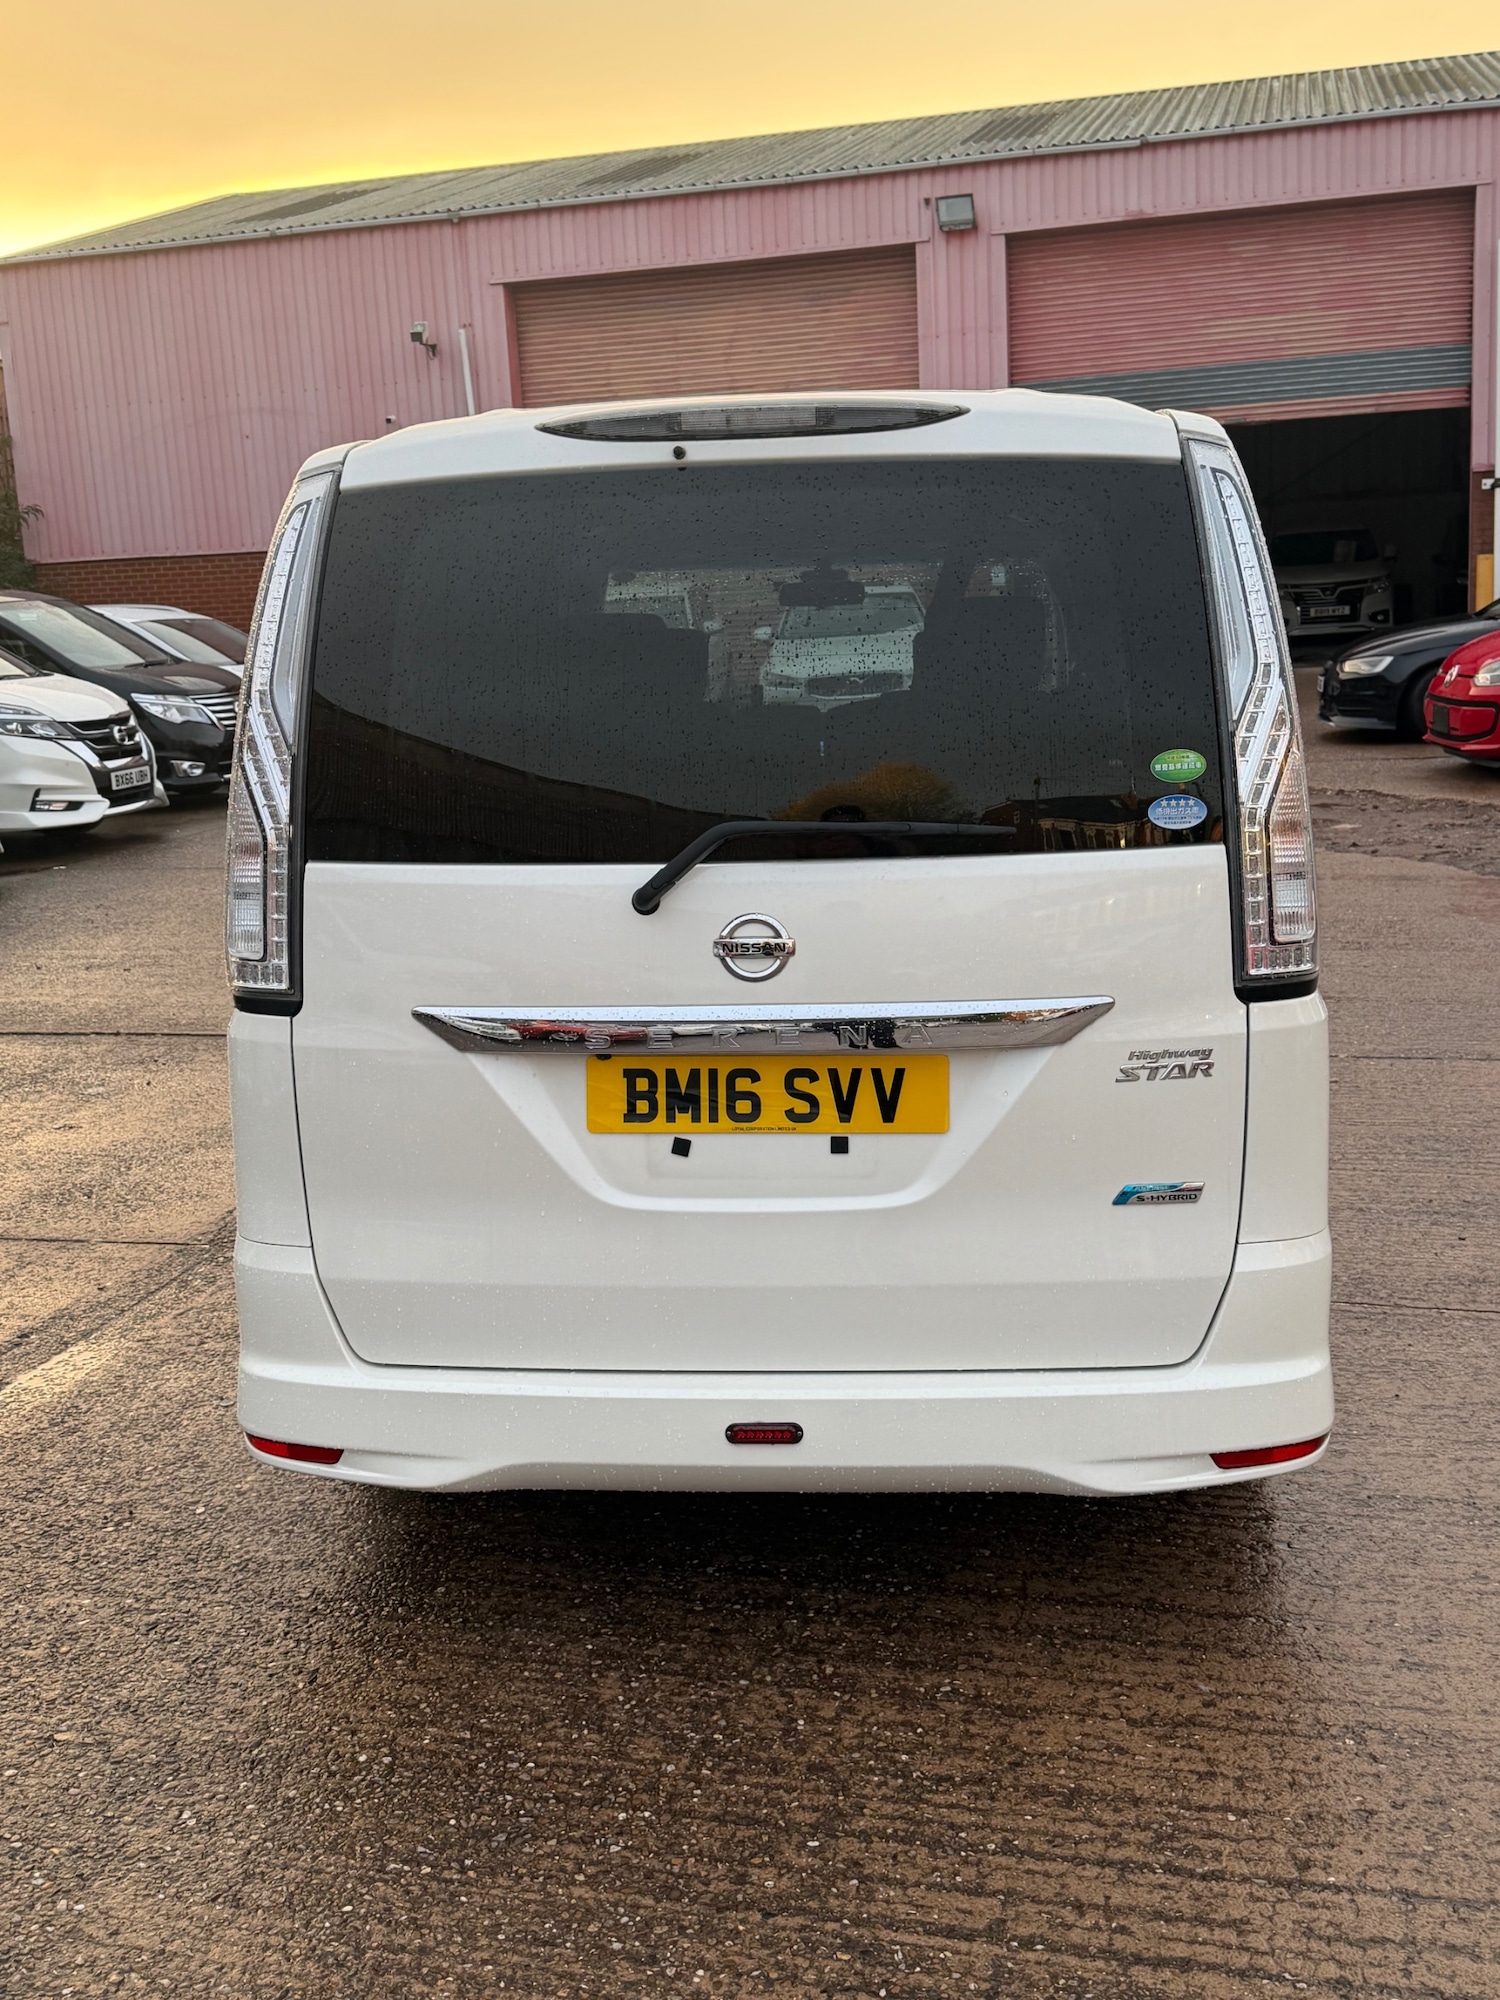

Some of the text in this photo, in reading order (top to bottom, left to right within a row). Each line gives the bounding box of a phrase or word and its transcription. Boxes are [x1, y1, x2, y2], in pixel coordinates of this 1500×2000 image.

[115, 772, 134, 787] BX66
[722, 942, 787, 953] NISSAN
[584, 1024, 934, 1050] SERENA
[1128, 1048, 1214, 1063] Highway
[1115, 1061, 1214, 1083] STAR
[622, 1067, 906, 1124] BM16 SVV
[1136, 1193, 1198, 1202] S-HYBRID
